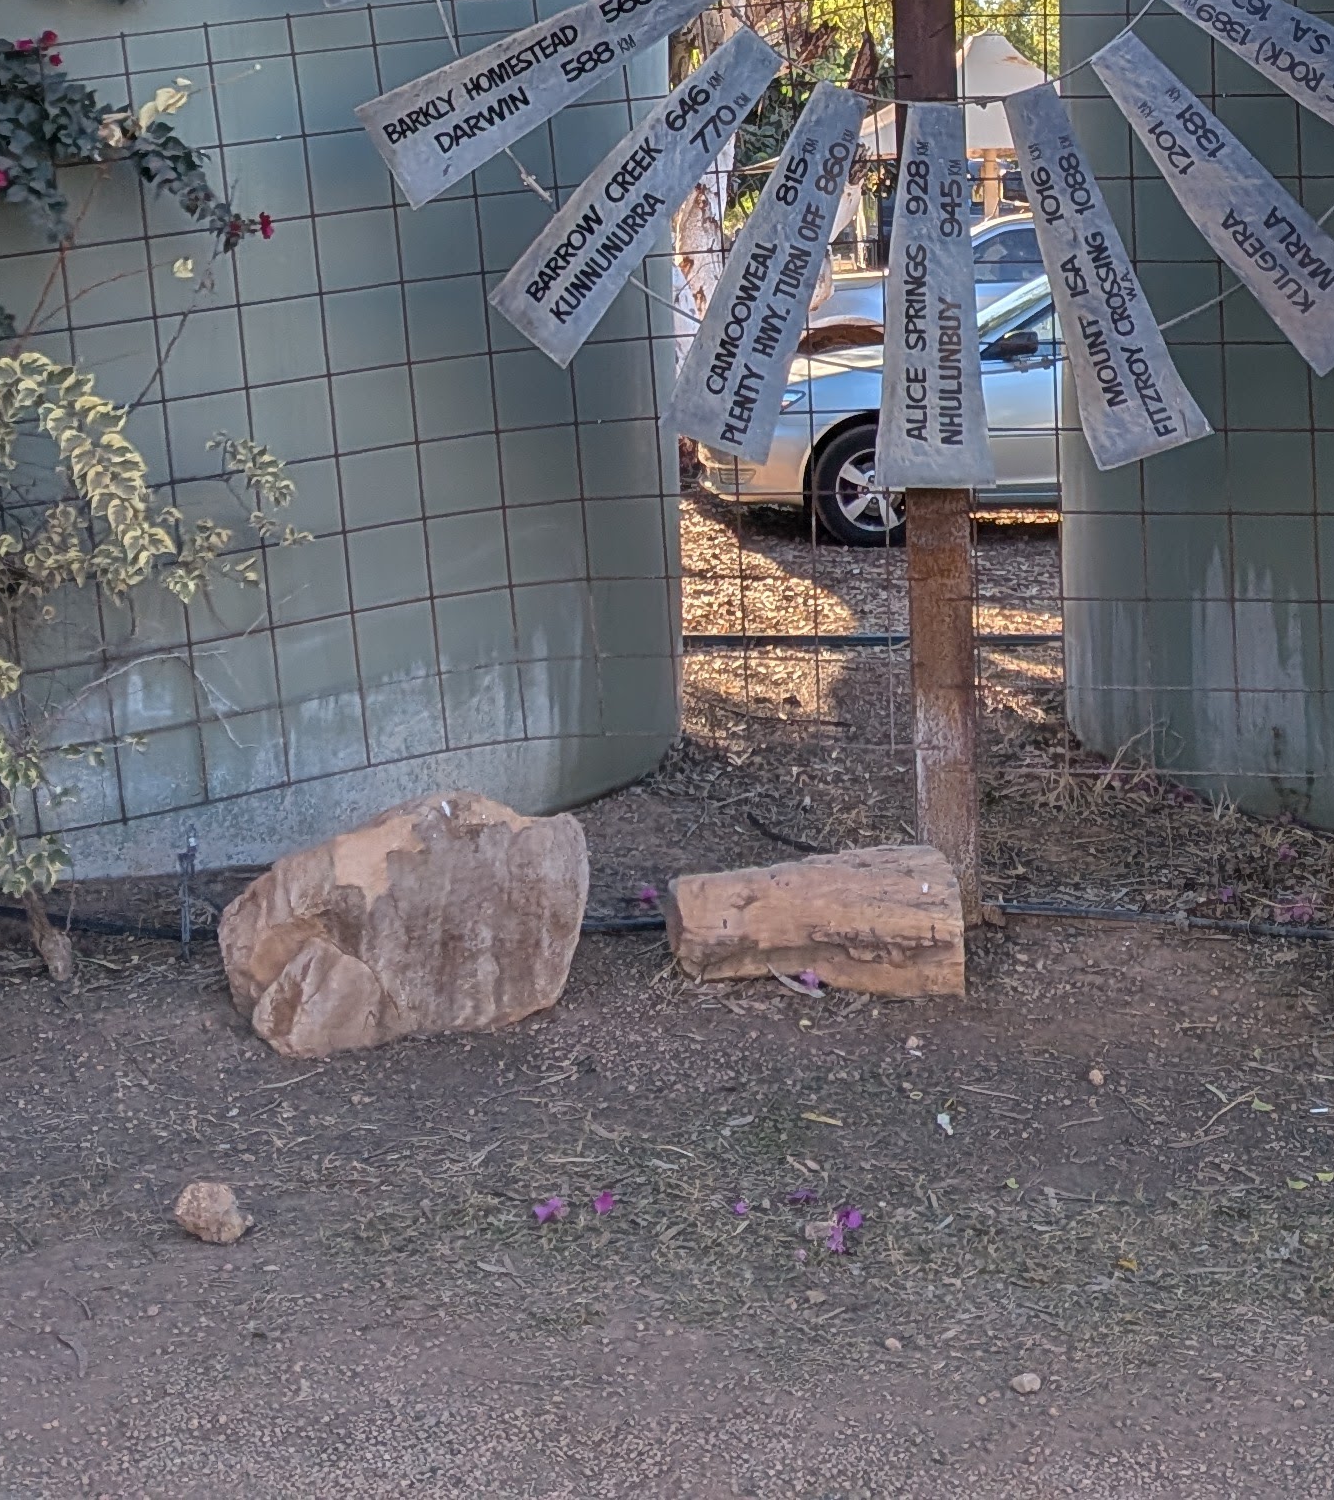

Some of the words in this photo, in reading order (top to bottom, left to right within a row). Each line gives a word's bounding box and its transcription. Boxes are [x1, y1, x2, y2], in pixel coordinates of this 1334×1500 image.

[1195, 2, 1252, 47] 1389
[1289, 17, 1331, 55] S.A.
[382, 88, 457, 145] BARKLY
[463, 24, 578, 100] HOMESTEAD
[434, 85, 531, 154] DARWIN
[560, 41, 615, 83] 588
[1175, 102, 1228, 160] 1381
[525, 204, 604, 303] BARROW
[604, 137, 664, 203] CREEK
[664, 85, 710, 131] 646
[906, 159, 929, 216] 928
[1058, 151, 1096, 215] 1088
[1147, 120, 1196, 177] 1201
[549, 191, 666, 324] KUNNUNURRA
[689, 106, 736, 153] 770
[940, 178, 963, 238] 945
[1029, 166, 1065, 226] 1016
[706, 242, 777, 395] CAMOOWEAL
[776, 155, 809, 207] 815
[720, 362, 765, 446] PLENTY
[773, 245, 813, 302] TURN
[797, 202, 826, 244] OFF
[814, 142, 850, 196] 860
[904, 243, 927, 352] SPRINGS
[1060, 255, 1088, 299] ISA
[1085, 230, 1137, 338] CROSSING
[1219, 207, 1316, 315] KULGERA
[906, 367, 928, 442] ALICE
[938, 297, 963, 446] NHULUNBUY
[1079, 315, 1129, 409] MOUNT
[1120, 346, 1178, 439] FITZROY
